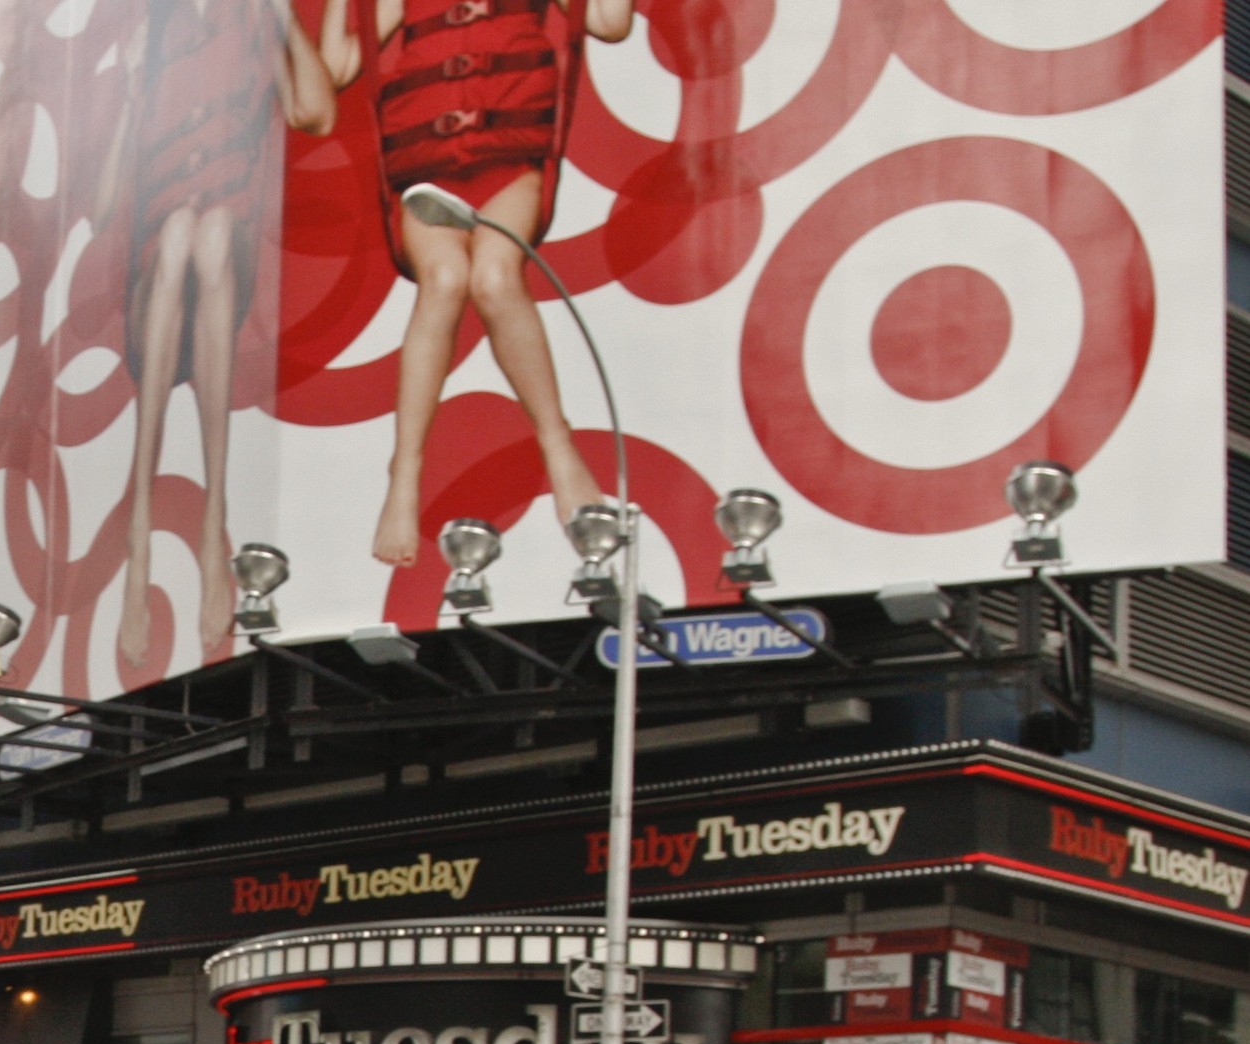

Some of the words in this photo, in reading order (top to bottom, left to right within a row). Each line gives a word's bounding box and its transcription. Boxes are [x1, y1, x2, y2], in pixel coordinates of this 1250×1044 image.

[698, 802, 905, 860] Tuesday
[1050, 805, 1130, 879] Ruby
[1127, 826, 1248, 910] Tuesday
[231, 872, 321, 916] Ruby
[320, 853, 480, 904] Tuesday
[19, 894, 145, 938] Tuesday
